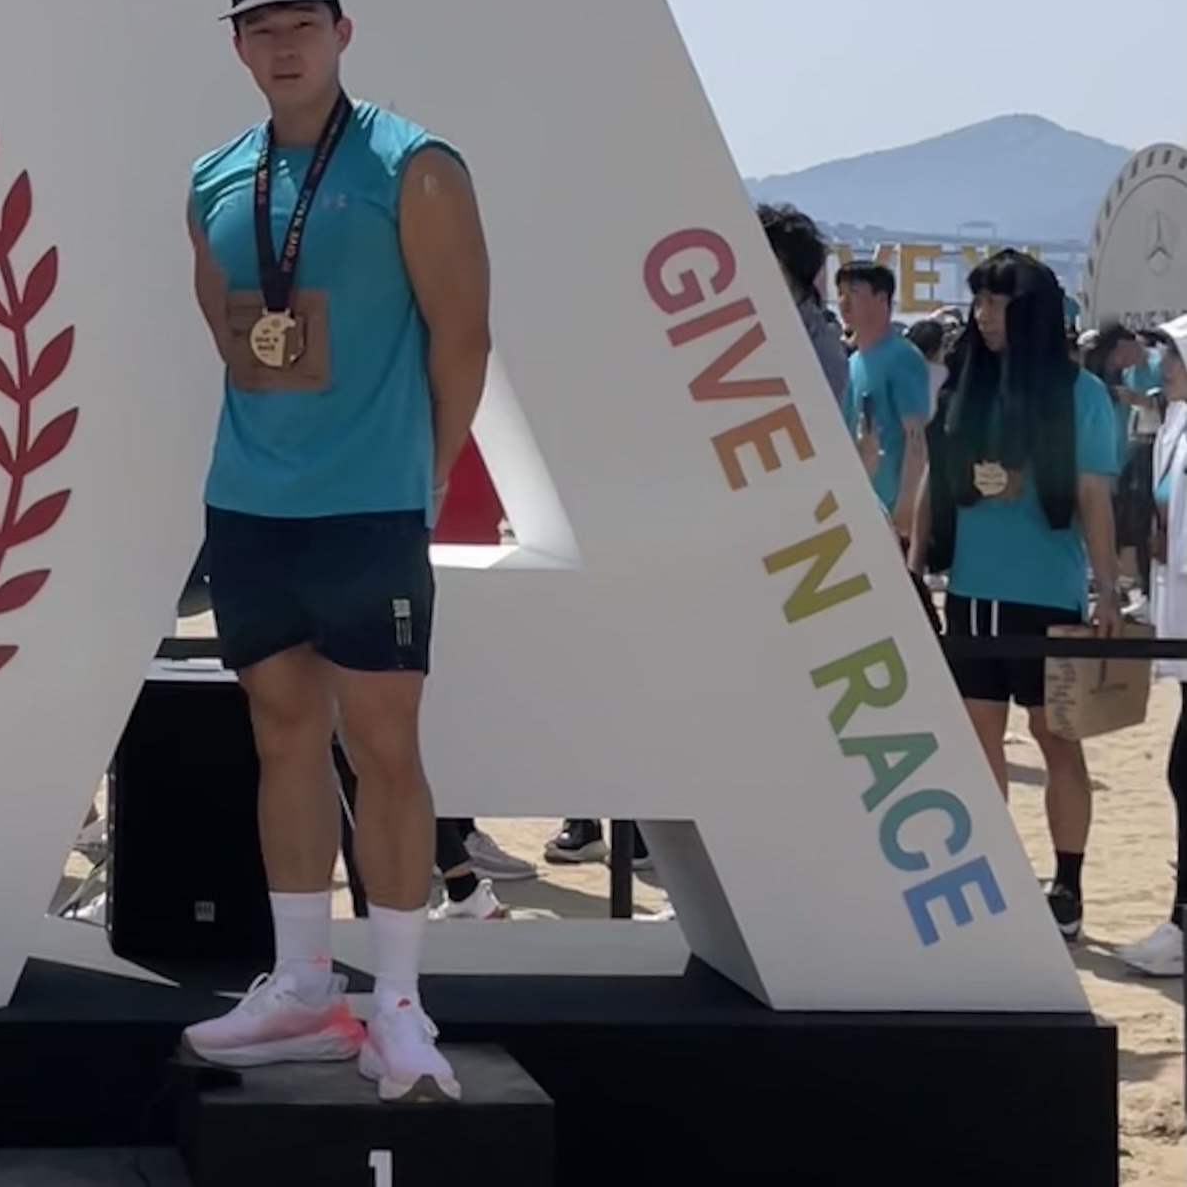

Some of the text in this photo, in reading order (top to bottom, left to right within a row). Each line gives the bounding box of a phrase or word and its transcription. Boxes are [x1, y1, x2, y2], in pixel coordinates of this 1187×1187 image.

[643, 227, 1007, 947] GIVE 'N RACE
[368, 1148, 394, 1187] 1
